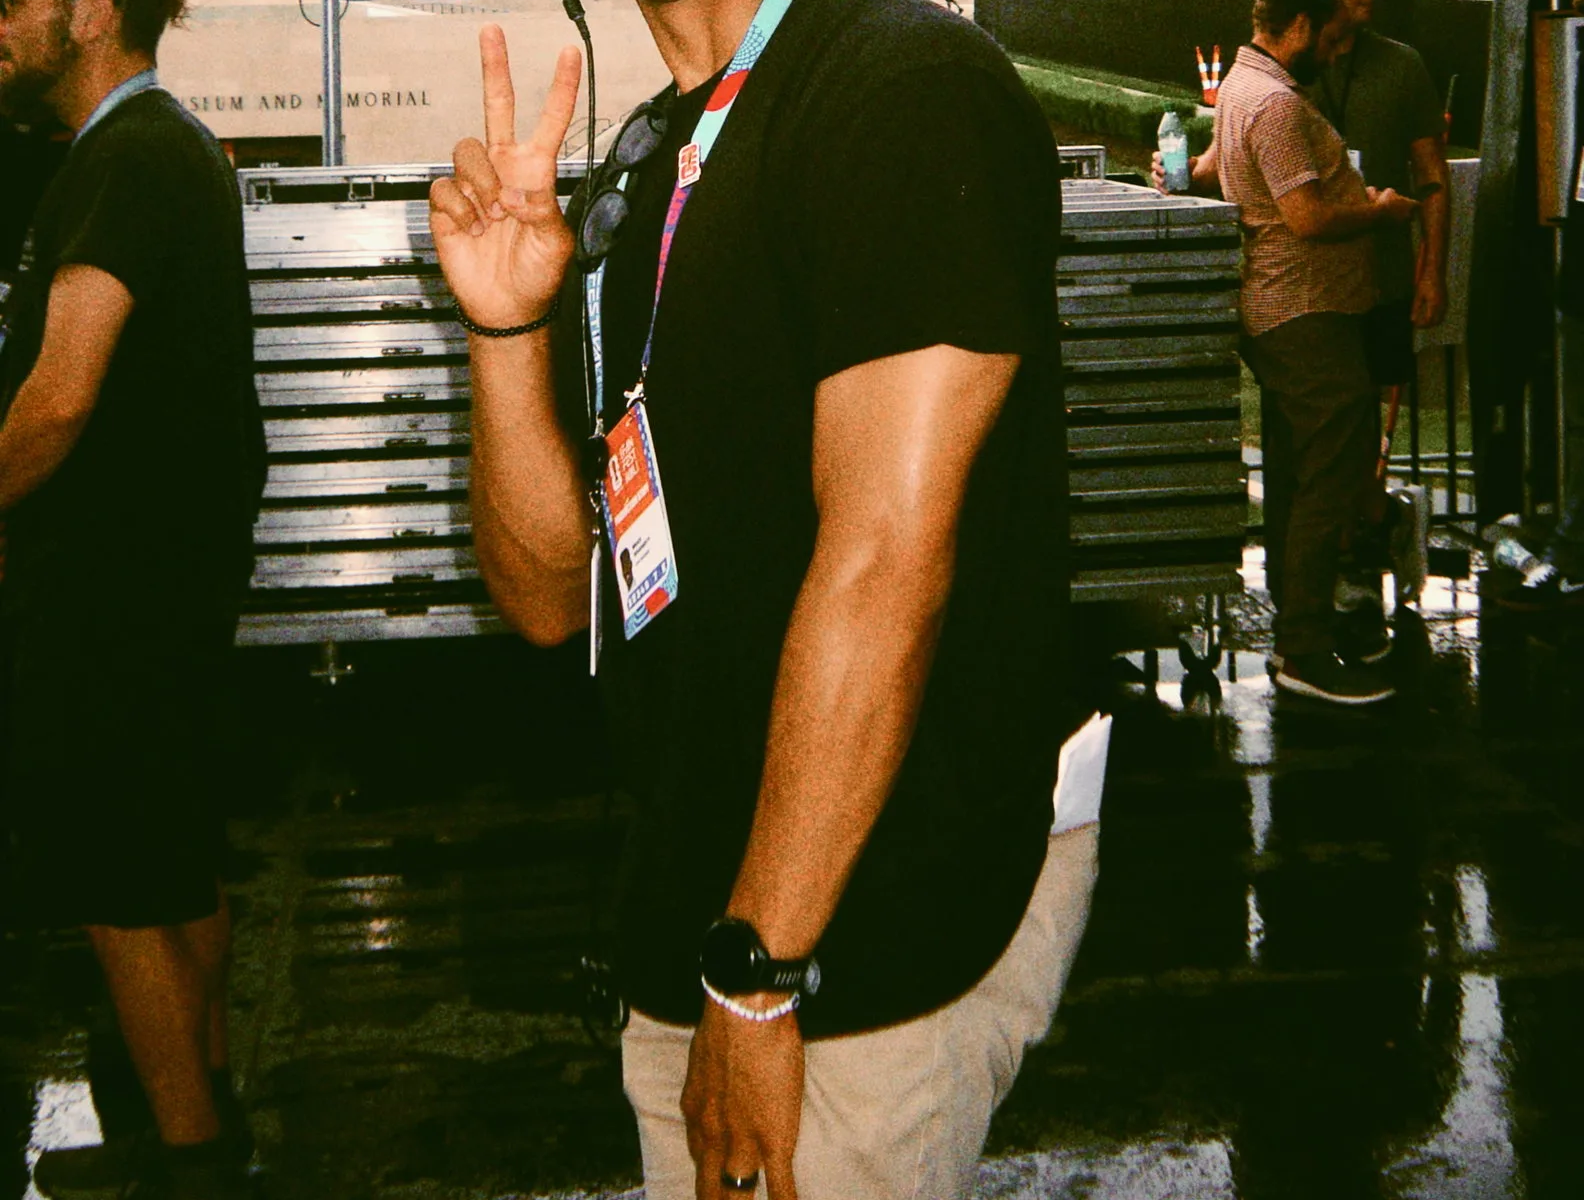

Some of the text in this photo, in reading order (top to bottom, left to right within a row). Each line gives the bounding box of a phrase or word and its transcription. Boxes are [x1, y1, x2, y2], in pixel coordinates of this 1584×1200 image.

[181, 90, 431, 112] SEUM AND MMORIAL
